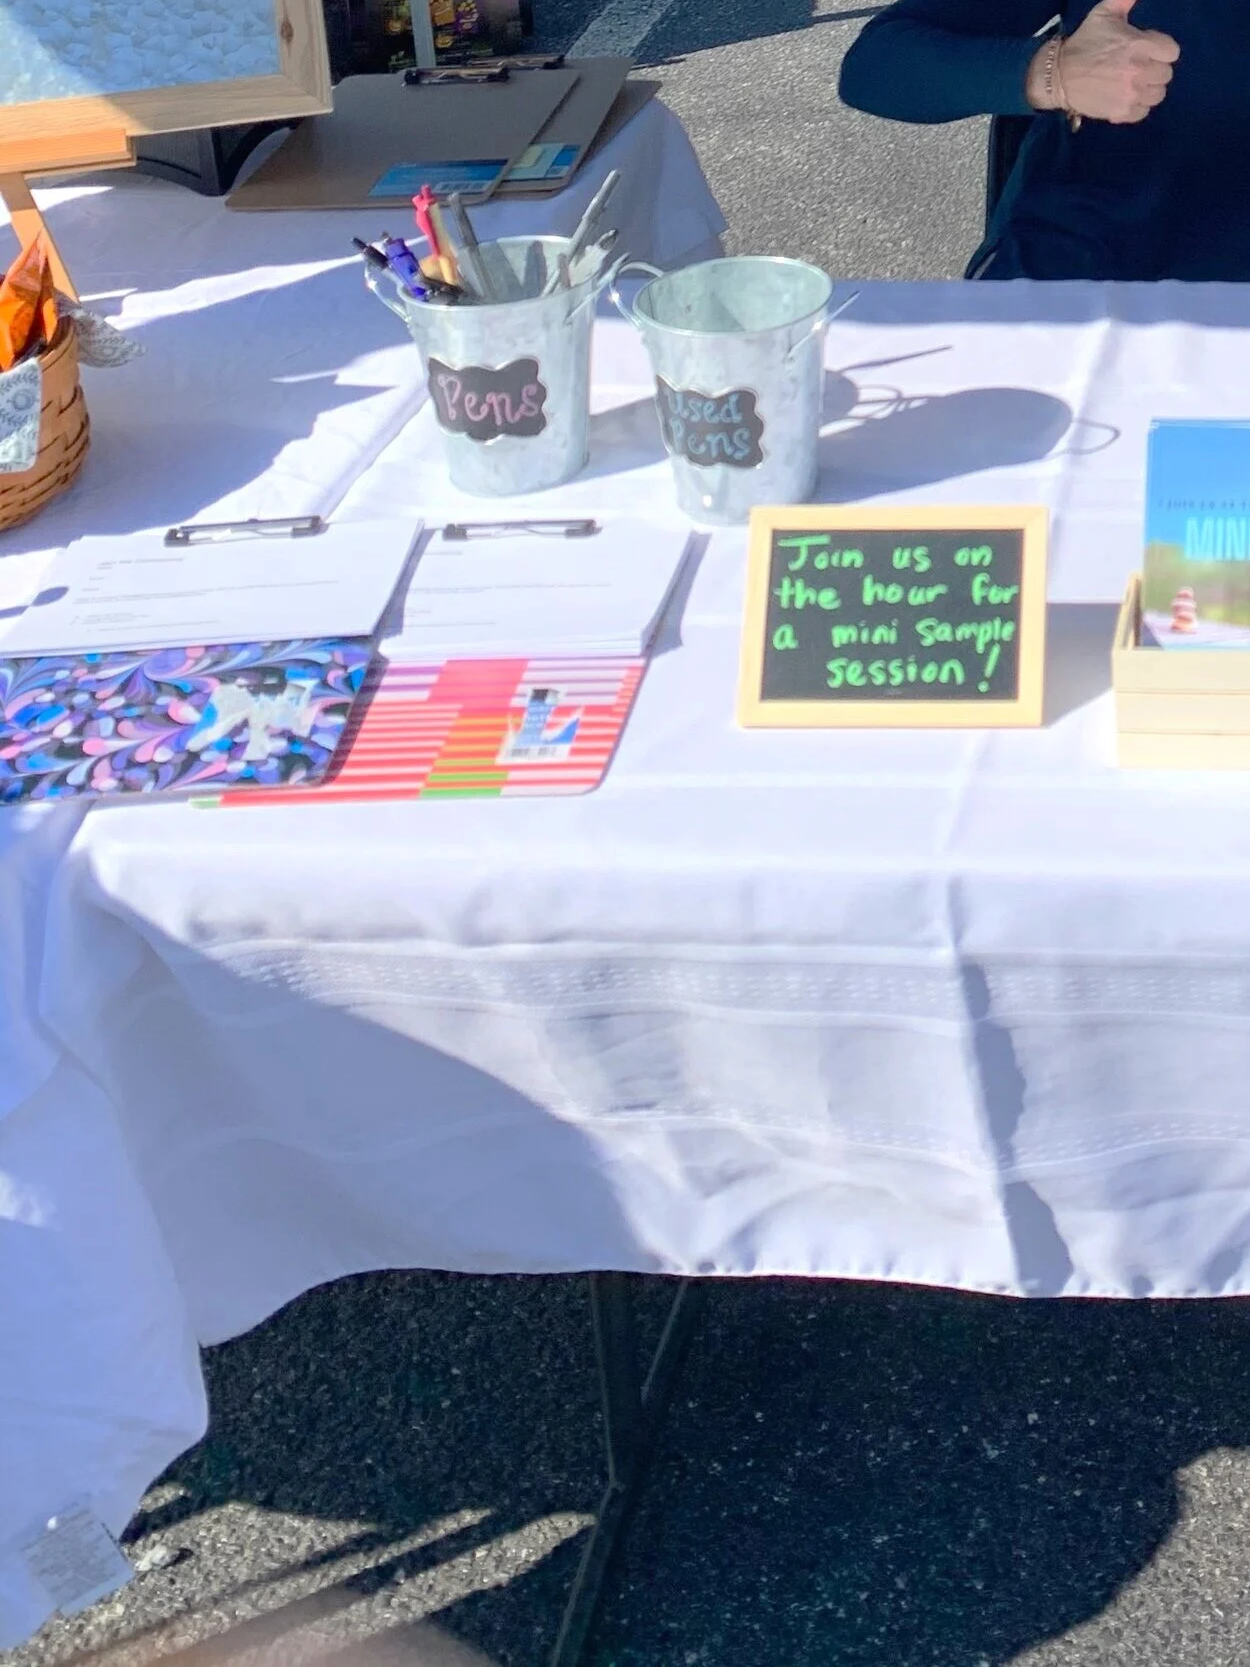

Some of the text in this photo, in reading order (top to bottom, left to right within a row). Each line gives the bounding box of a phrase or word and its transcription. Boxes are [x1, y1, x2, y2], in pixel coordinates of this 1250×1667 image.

[437, 373, 540, 425] Pens
[667, 392, 742, 424] Used
[672, 418, 752, 459] Pens
[777, 534, 993, 572] Join us on
[774, 572, 1019, 610] the hour for
[772, 623, 799, 650] a
[831, 618, 899, 648] mini
